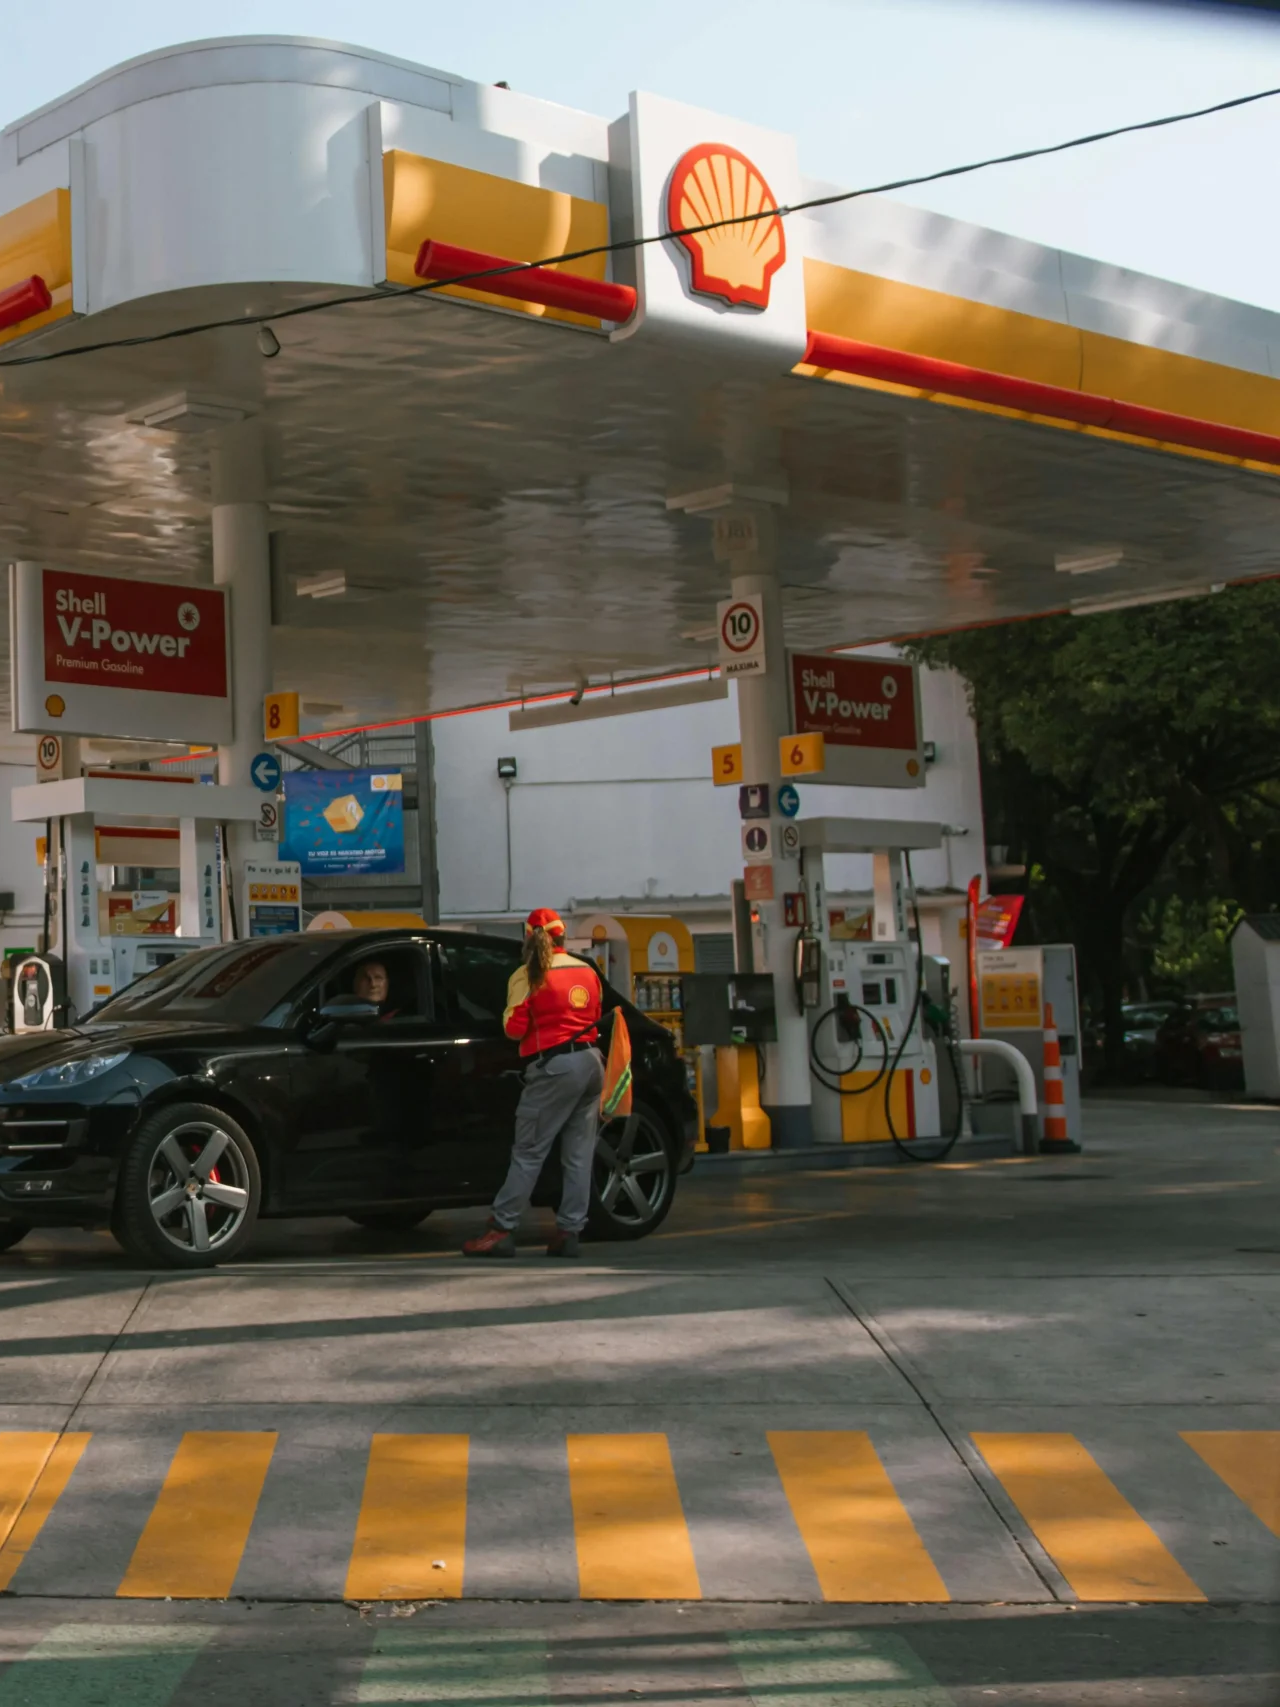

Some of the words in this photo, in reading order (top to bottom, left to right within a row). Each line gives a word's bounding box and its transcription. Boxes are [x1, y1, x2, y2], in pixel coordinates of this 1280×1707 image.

[55, 588, 107, 617] Shell
[729, 612, 751, 636] 10
[56, 615, 191, 658] V-Power
[56, 654, 99, 671] Premium
[101, 658, 145, 675] Gasoline
[801, 668, 835, 690] Shell
[803, 689, 892, 721] V-Power
[269, 704, 280, 730] 8
[42, 741, 55, 758] 10
[790, 744, 803, 766] 6
[722, 754, 734, 775] 5
